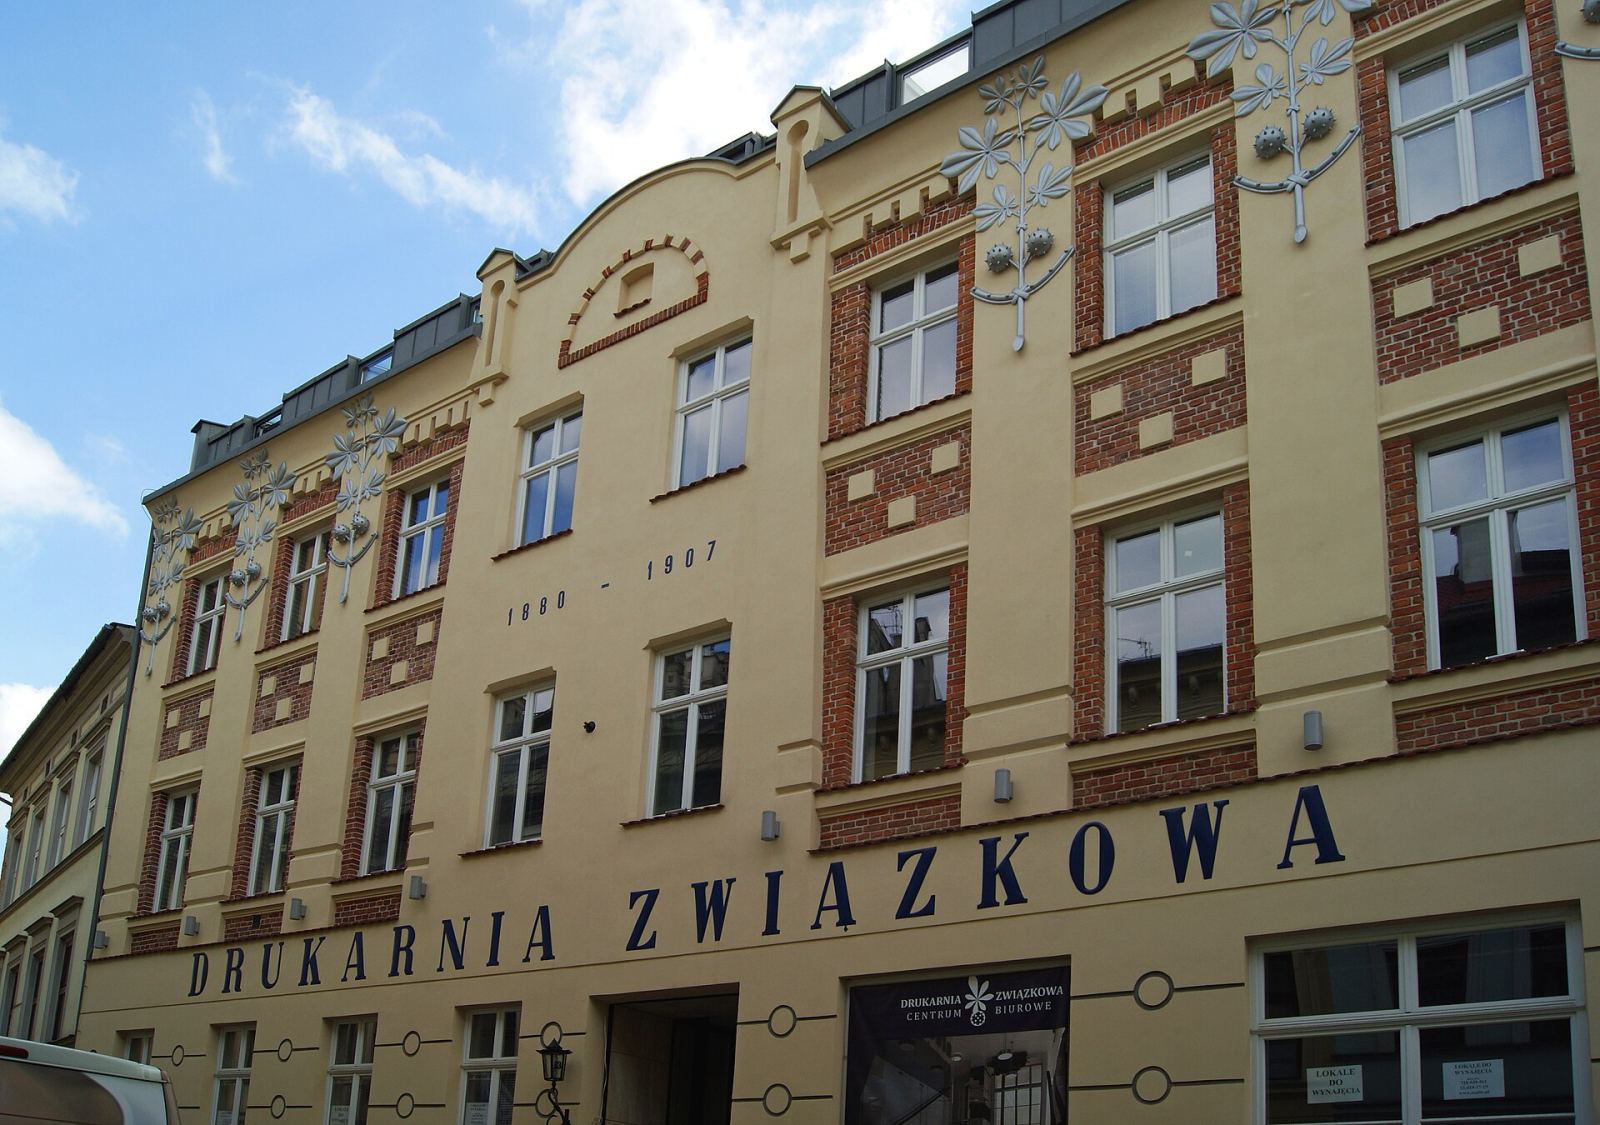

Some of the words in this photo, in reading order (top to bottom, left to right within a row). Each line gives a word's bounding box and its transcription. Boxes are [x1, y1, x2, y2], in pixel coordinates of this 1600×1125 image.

[508, 590, 565, 626] 1880
[648, 540, 716, 580] 1907
[188, 905, 555, 997] DRUKARNIA
[626, 785, 1345, 951] ZWIĄZKOWA
[900, 995, 962, 1009] DRUKARNIA
[995, 985, 1064, 1001] ZWIĄZKOWA
[906, 1009, 962, 1021] CENTRUM
[995, 1001, 1052, 1015] BIUROWE
[1316, 1068, 1356, 1078] LOKALE
[1312, 1087, 1361, 1096] WYNAJĘCIA
